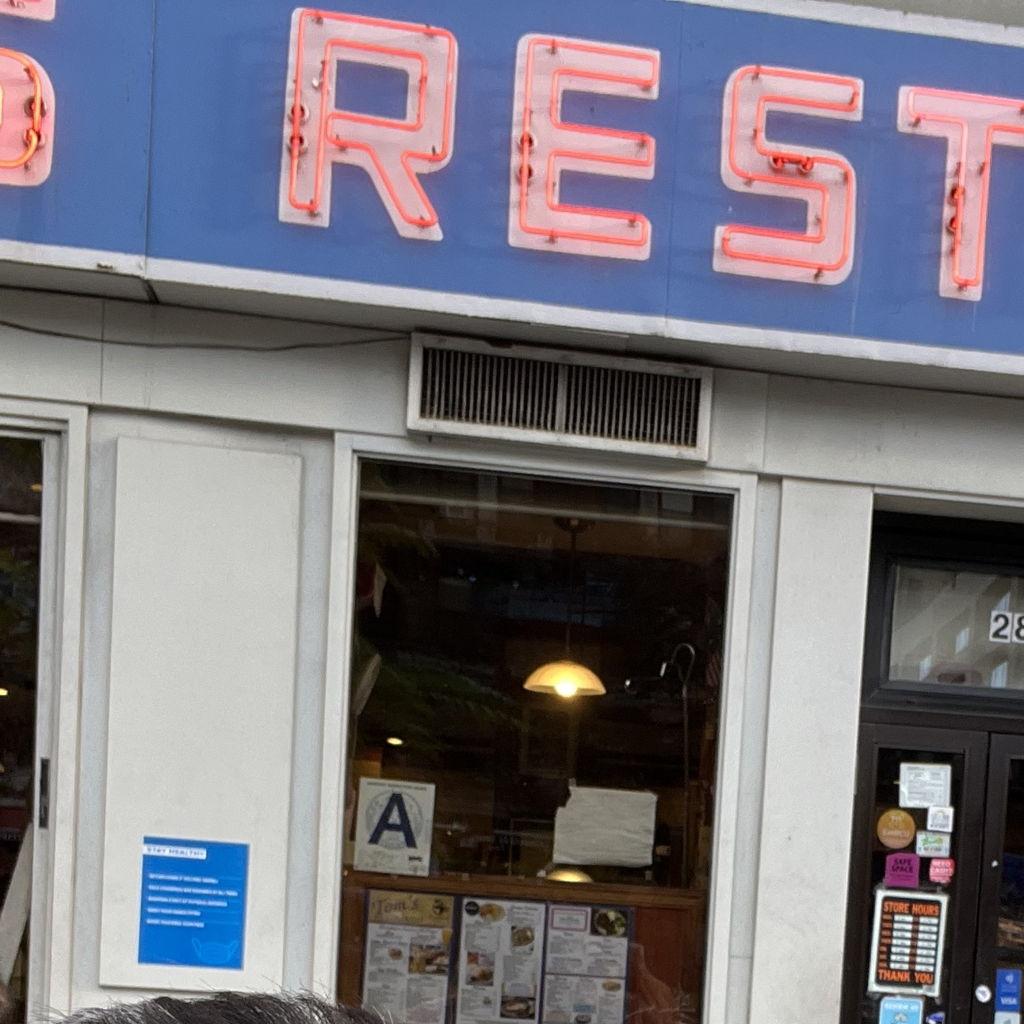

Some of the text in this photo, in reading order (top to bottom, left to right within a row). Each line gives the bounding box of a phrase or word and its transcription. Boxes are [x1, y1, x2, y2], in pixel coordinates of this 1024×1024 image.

[367, 793, 417, 849] A
[883, 901, 939, 916] STORE HOURS
[878, 969, 933, 984] THANK YOU
[1000, 997, 1017, 1005] VISA
